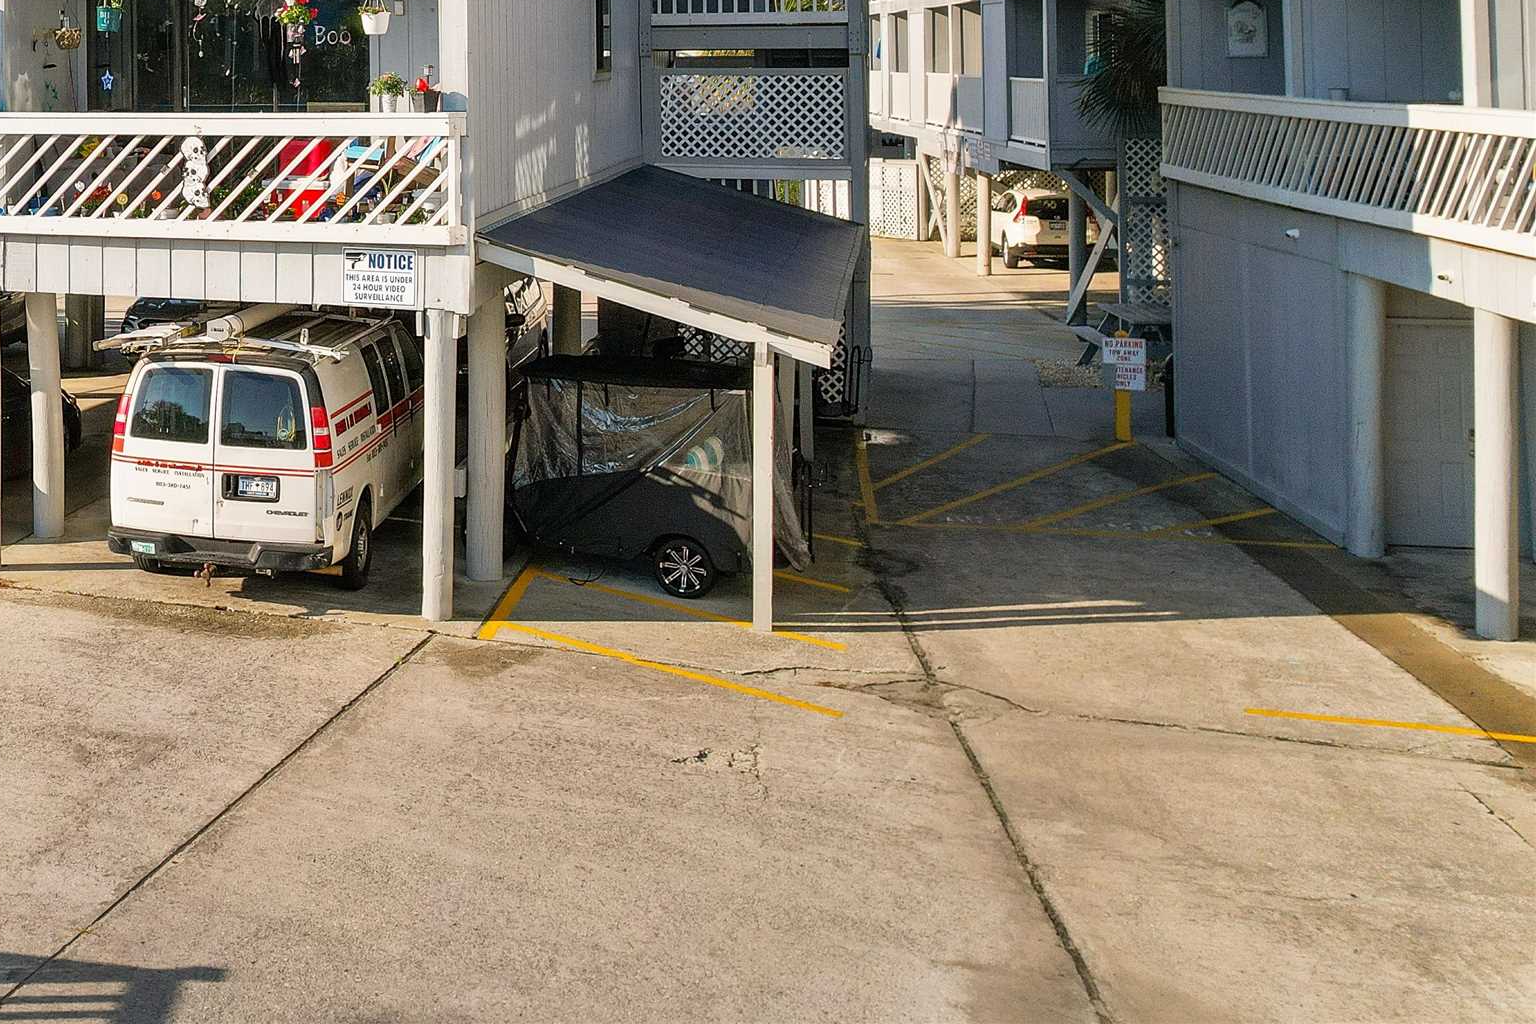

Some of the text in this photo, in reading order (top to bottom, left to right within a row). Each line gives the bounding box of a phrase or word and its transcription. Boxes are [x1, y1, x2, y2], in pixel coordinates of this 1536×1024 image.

[314, 25, 351, 45] Boo
[368, 253, 413, 270] NOTICE
[382, 275, 388, 283] IS
[390, 276, 413, 284] UNDER
[353, 283, 406, 293] 24 HOUR VIDEO
[354, 293, 404, 302] SURVEILLANCE
[1115, 340, 1143, 348] PARKING
